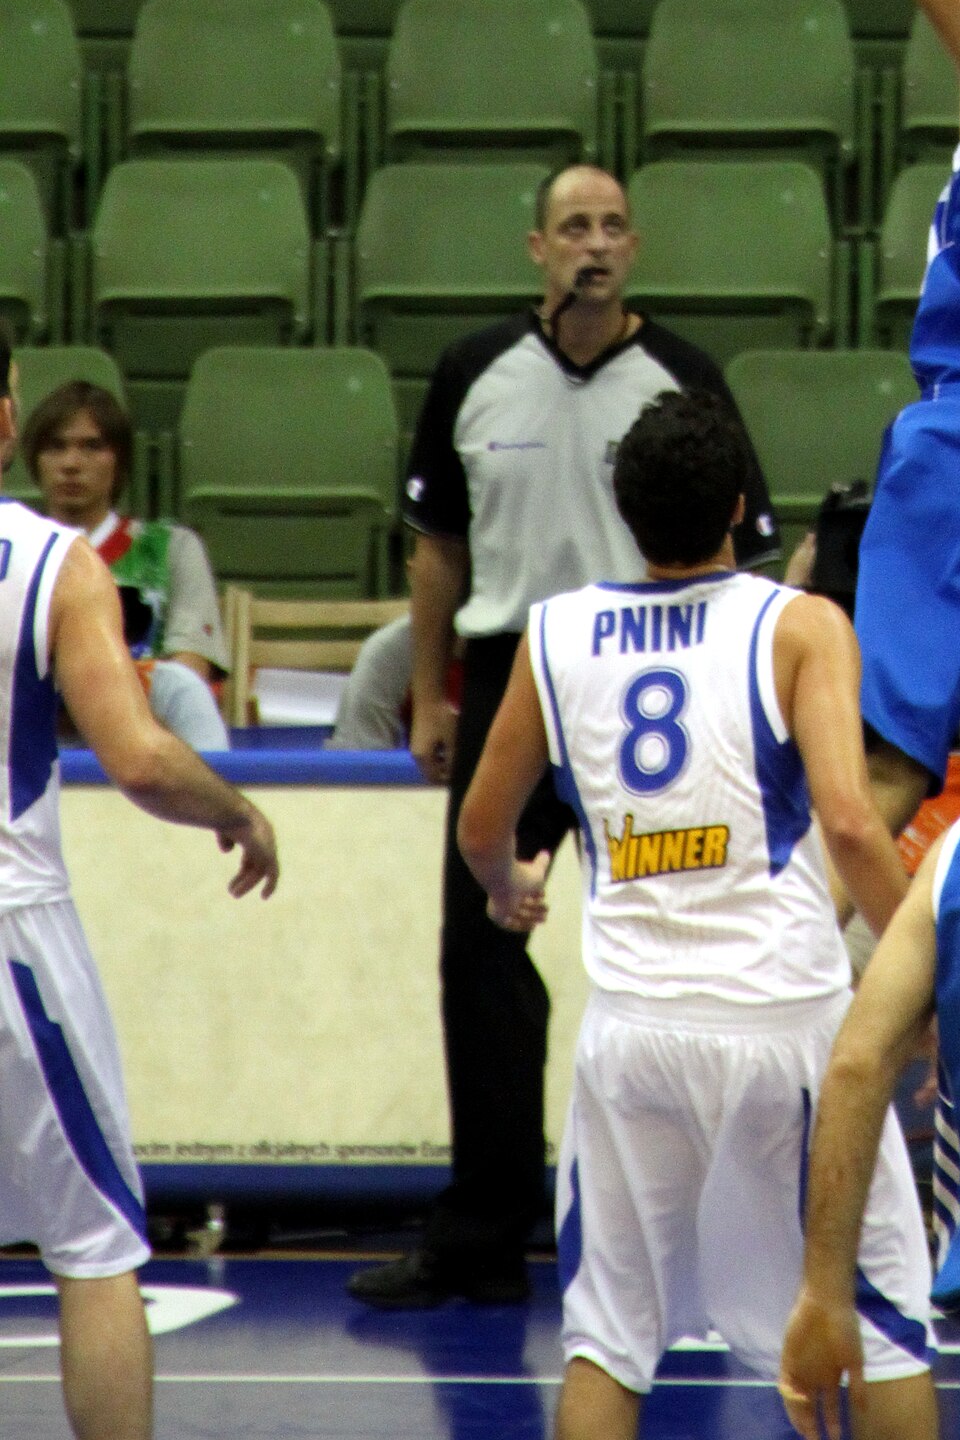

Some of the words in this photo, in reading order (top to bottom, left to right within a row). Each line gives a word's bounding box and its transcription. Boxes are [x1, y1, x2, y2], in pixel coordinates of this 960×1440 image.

[592, 601, 708, 657] PNINI
[615, 665, 692, 798] 8
[603, 813, 730, 884] WINNER
